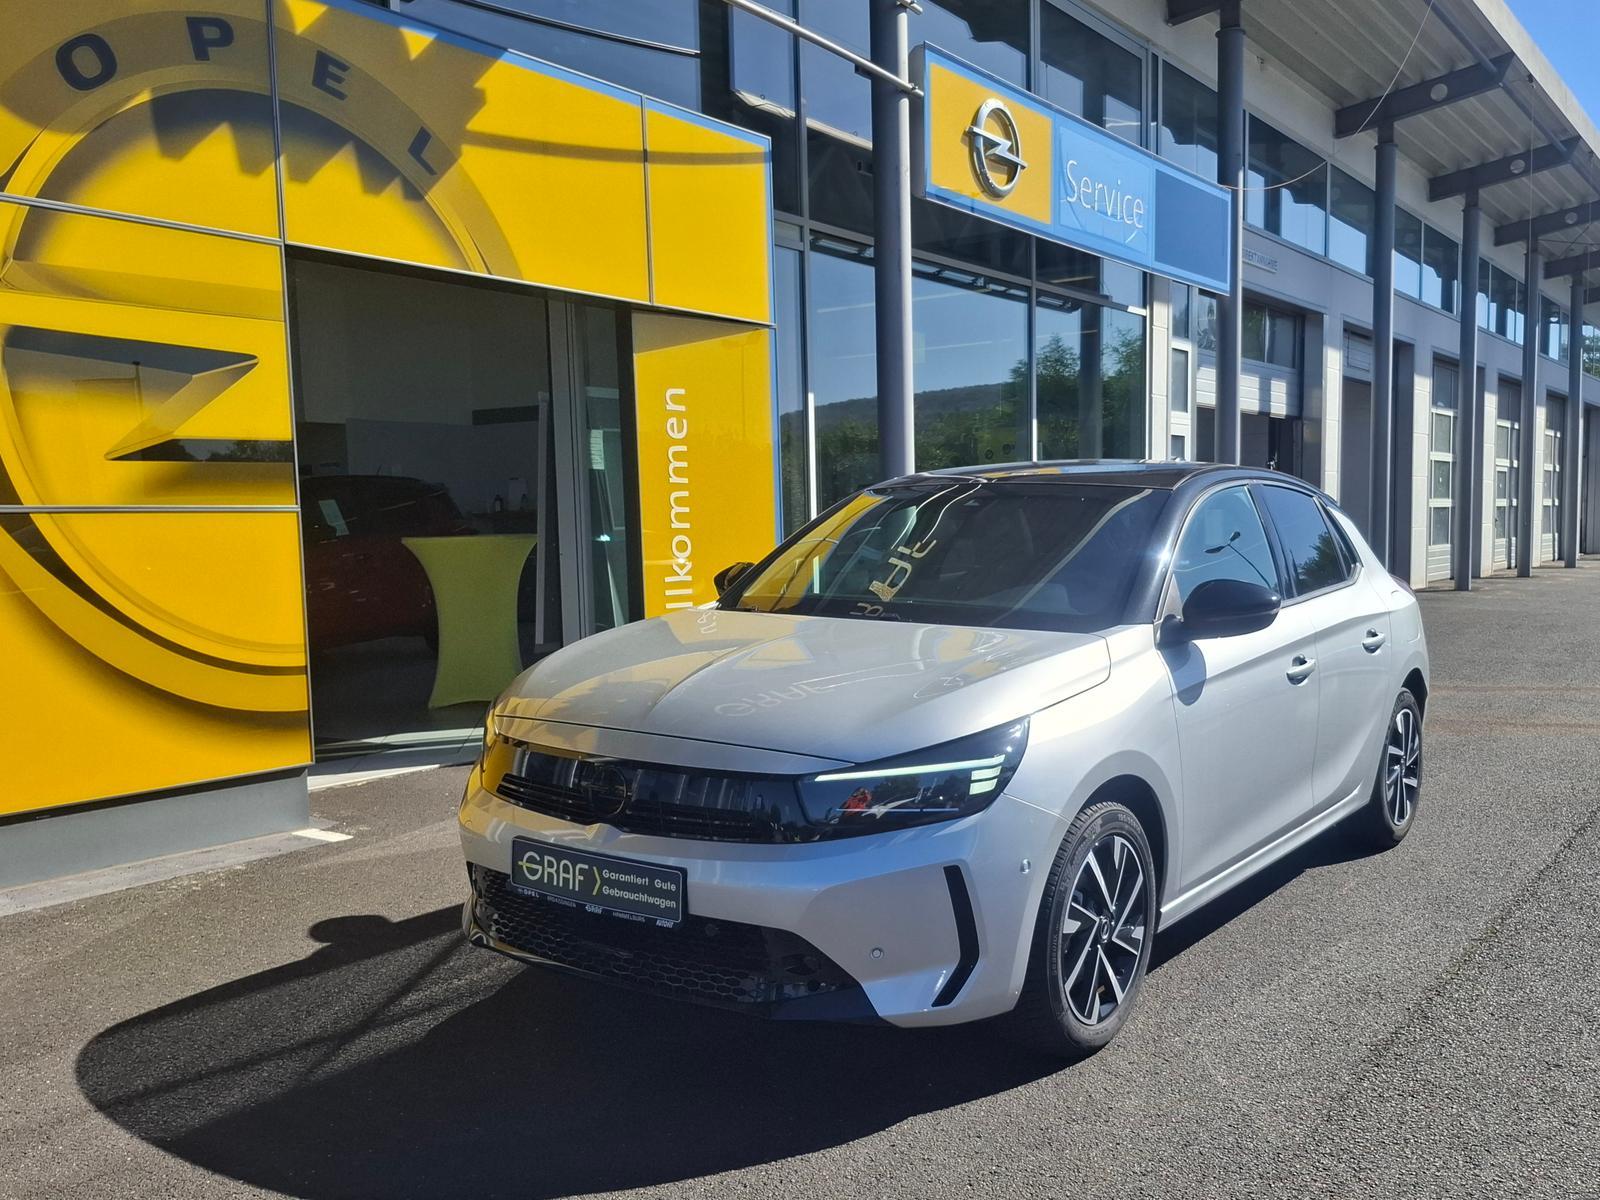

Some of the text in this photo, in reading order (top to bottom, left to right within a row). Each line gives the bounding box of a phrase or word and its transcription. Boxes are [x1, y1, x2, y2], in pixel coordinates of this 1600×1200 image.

[55, 16, 438, 176] OPEL
[1065, 159, 1144, 228] Service
[664, 387, 693, 609] llkommen
[518, 851, 589, 892] GRAF
[602, 869, 677, 892] Garantiert Gute
[602, 885, 677, 909] Gebrauchtwagen
